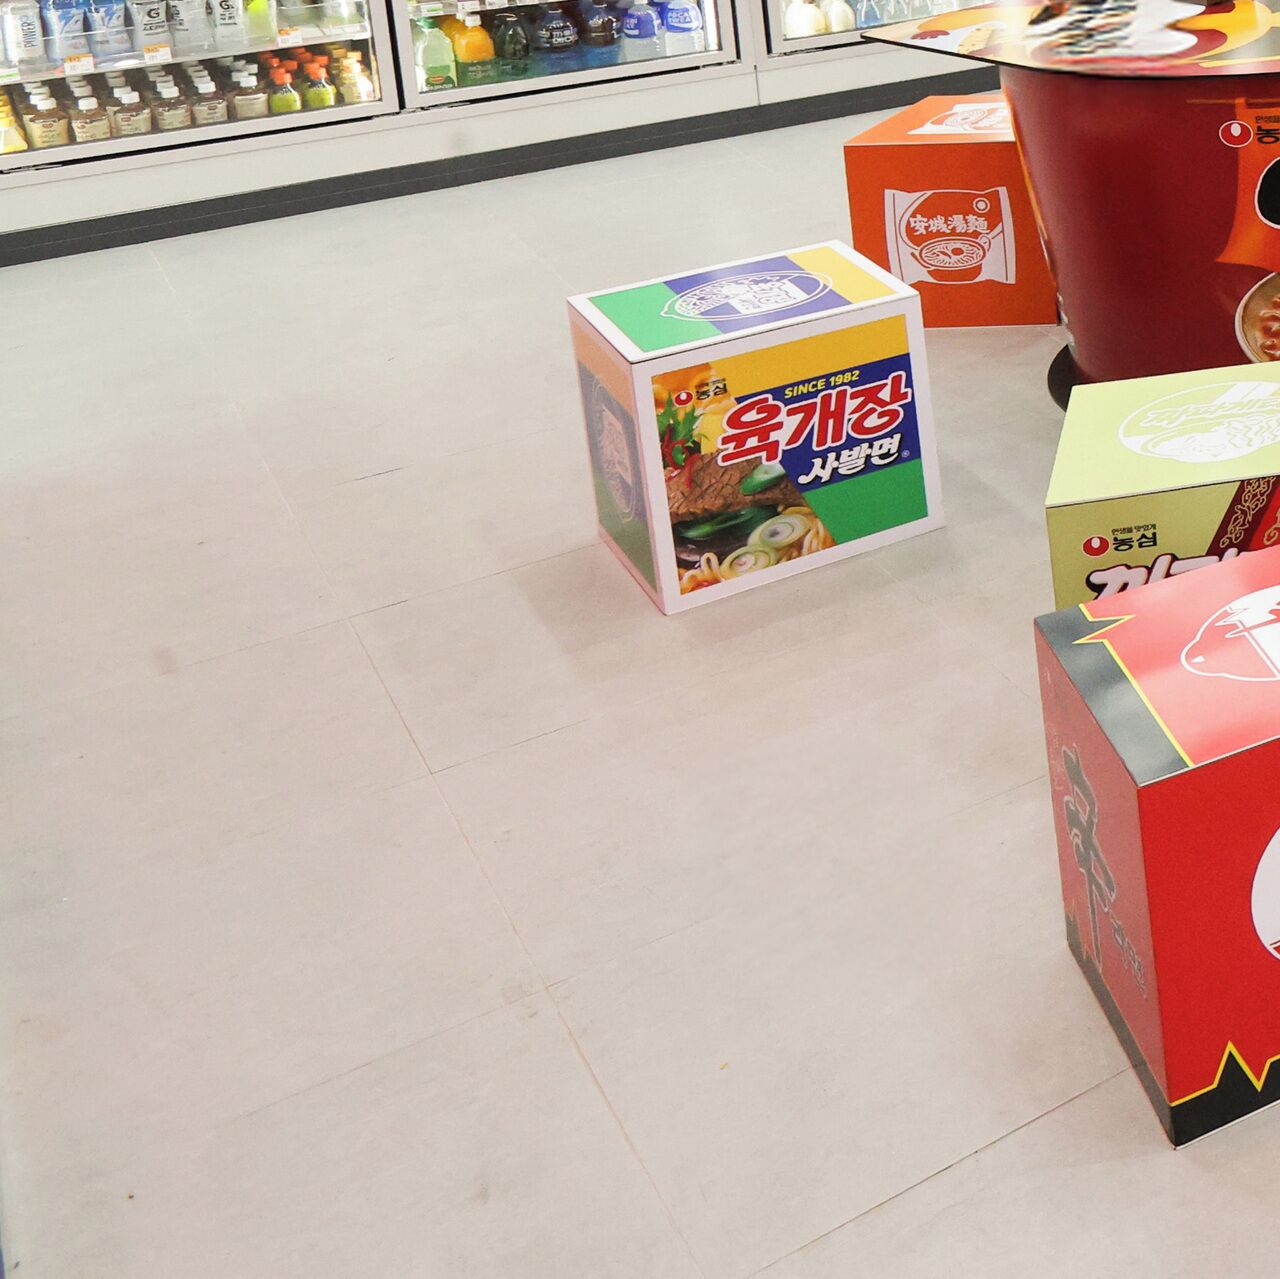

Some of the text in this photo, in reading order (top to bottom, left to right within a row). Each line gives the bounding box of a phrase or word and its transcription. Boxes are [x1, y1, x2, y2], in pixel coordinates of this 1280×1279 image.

[784, 369, 860, 399] SINCE 1982
[717, 371, 912, 466] 육개장
[798, 433, 902, 486] 사발면
[1113, 532, 1158, 551] 농심
